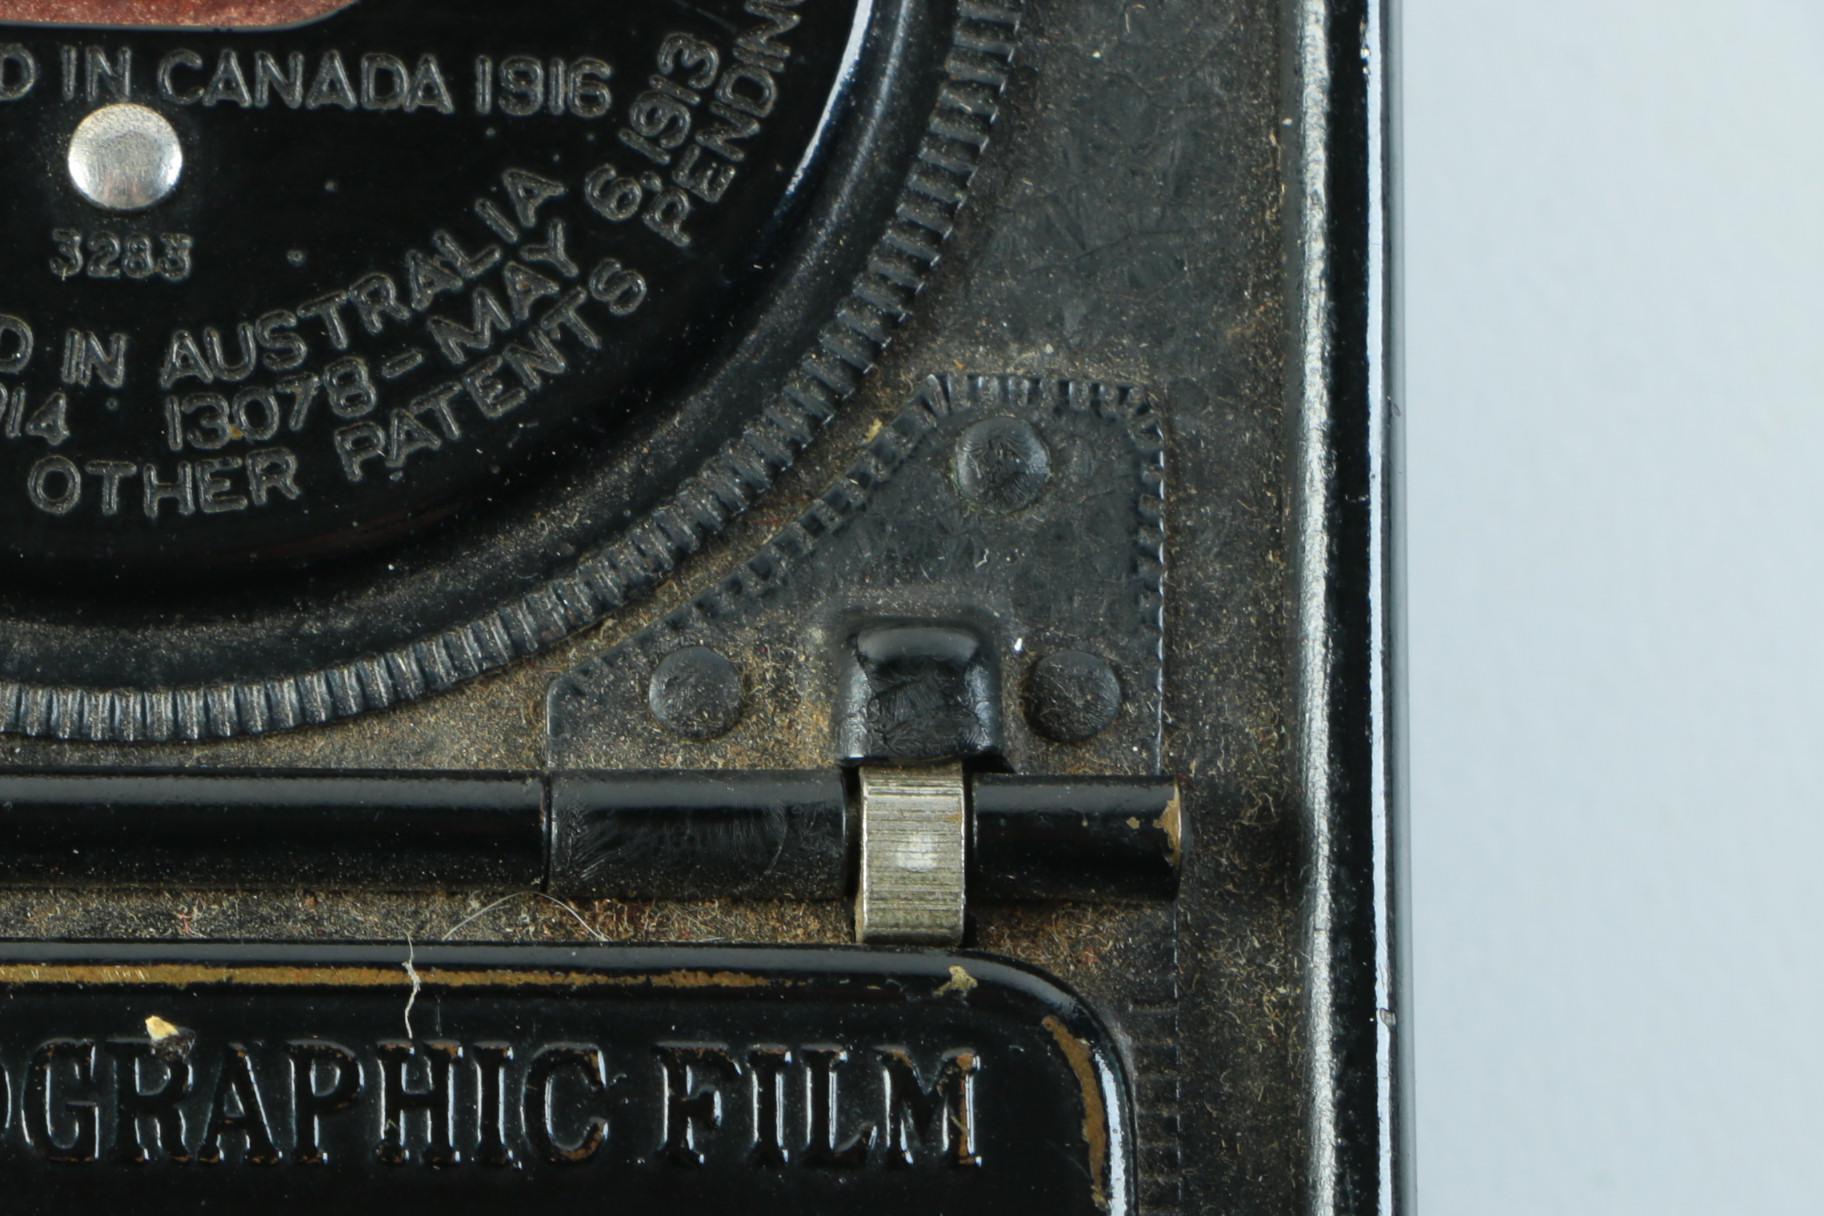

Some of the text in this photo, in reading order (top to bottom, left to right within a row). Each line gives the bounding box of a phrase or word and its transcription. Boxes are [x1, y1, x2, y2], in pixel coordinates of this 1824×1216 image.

[62, 45, 131, 101] IN
[157, 48, 454, 113] CANADA
[474, 54, 613, 118] 1916
[27, 0, 802, 520] OTHER PATENTS PENDIN
[61, 329, 128, 388] IN
[160, 167, 566, 389] AUSTRALIA
[655, 1040, 983, 1167] FILM
